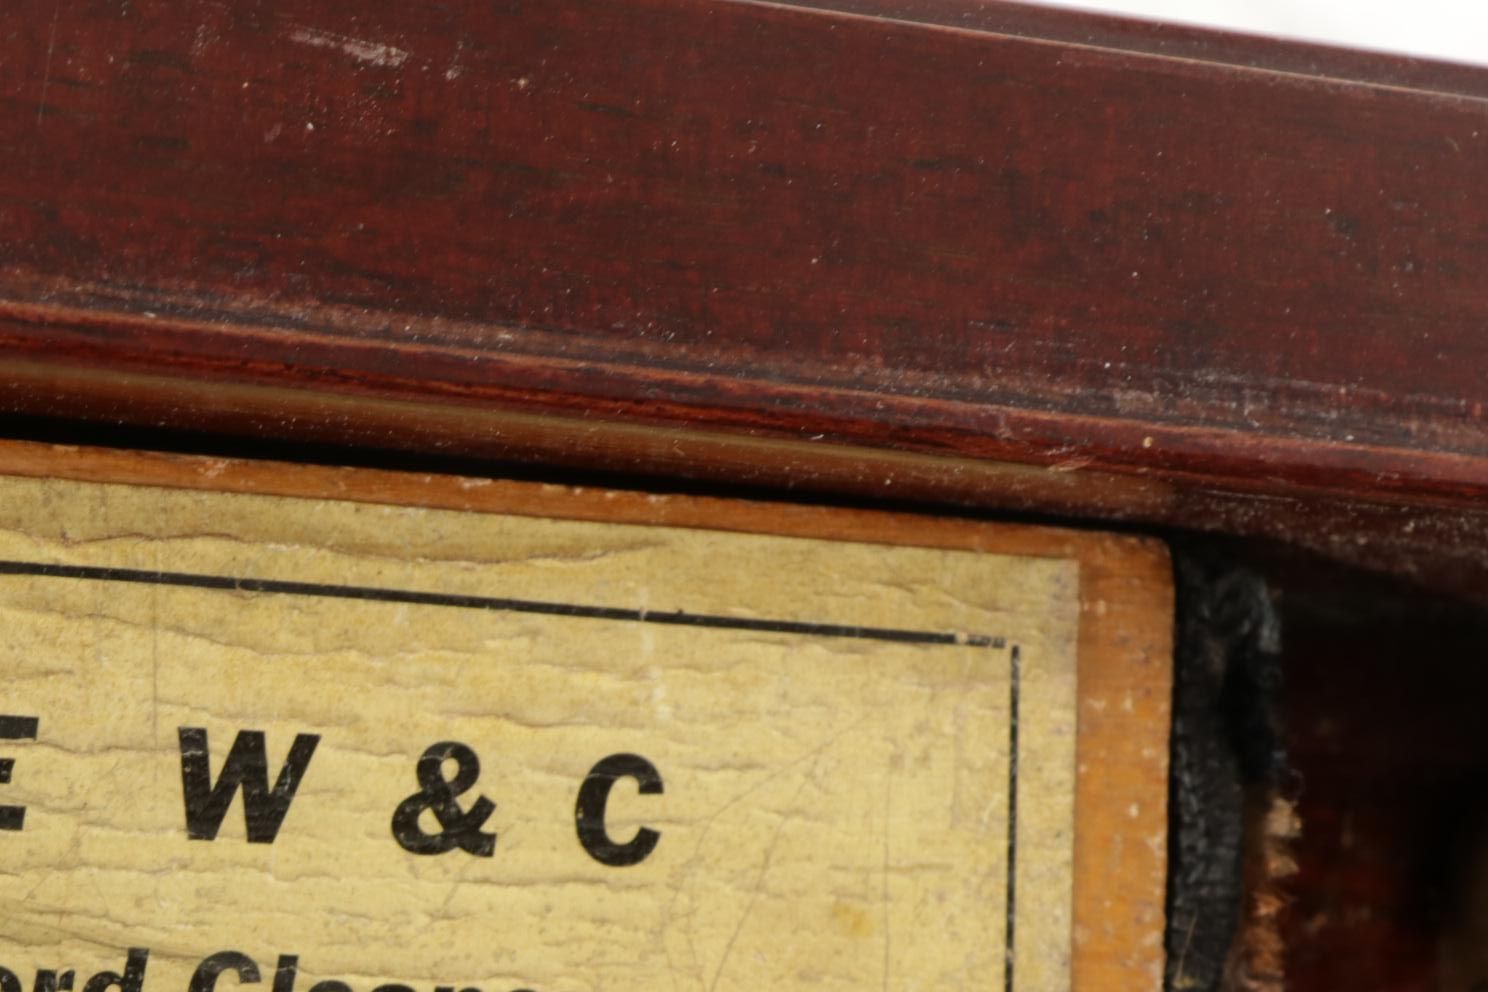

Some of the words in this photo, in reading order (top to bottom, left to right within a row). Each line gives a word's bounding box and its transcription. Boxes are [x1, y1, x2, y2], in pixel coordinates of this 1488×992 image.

[176, 726, 322, 845] W
[389, 740, 498, 858] &
[573, 753, 665, 868] C
